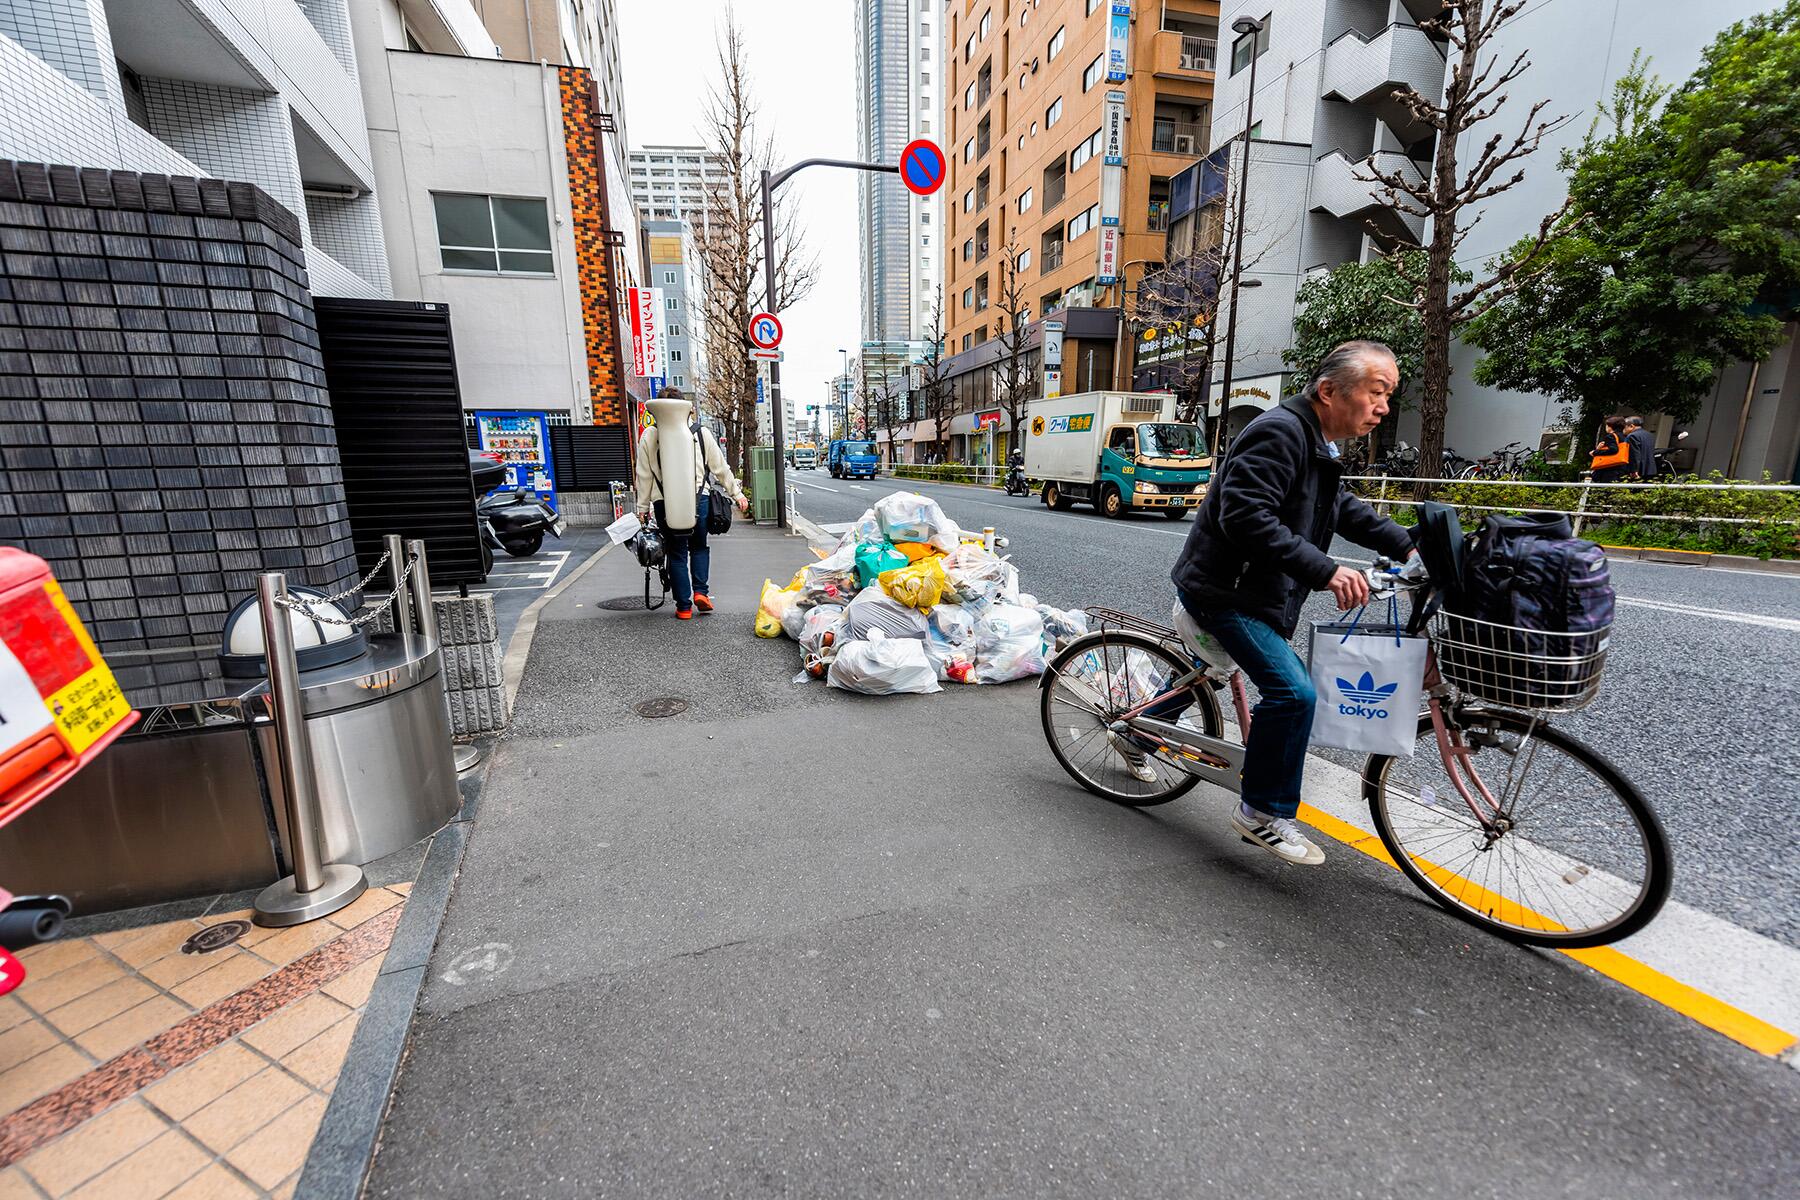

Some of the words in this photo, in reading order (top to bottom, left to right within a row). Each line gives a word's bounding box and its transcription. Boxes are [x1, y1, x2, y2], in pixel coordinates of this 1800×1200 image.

[642, 291, 656, 373] コインランドリー
[1338, 703, 1388, 720] tokyo
